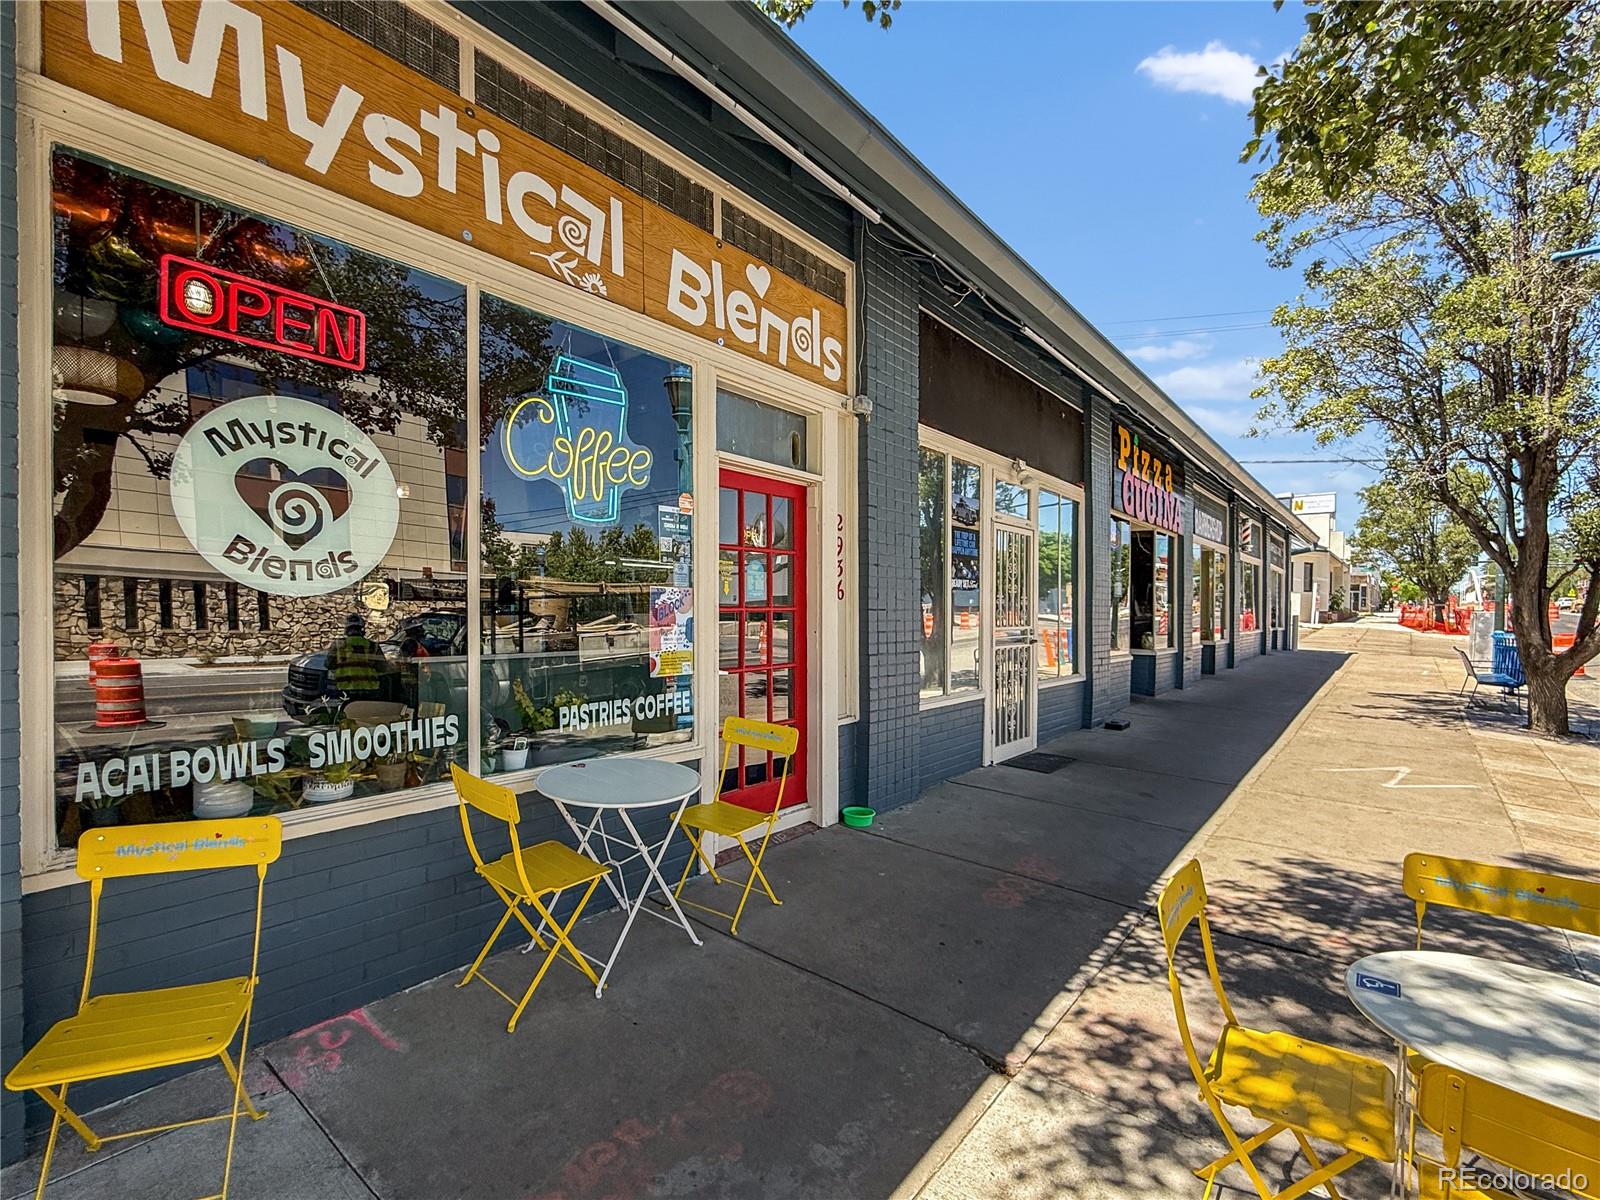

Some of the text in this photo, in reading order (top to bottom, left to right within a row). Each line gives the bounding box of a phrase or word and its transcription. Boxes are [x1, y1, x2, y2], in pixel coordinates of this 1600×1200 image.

[85, 0, 842, 382] Mystical Blends
[175, 270, 355, 361] OPEN
[203, 418, 380, 479] Mystical
[506, 397, 651, 501] Coffee
[1118, 425, 1174, 493] Pizza
[222, 534, 358, 581] Blends
[657, 597, 685, 621] BLOCK
[309, 715, 459, 769] SMOOTHIES
[559, 690, 691, 733] PASTRIES COFFEE
[75, 738, 286, 803] ACAI BOWLS
